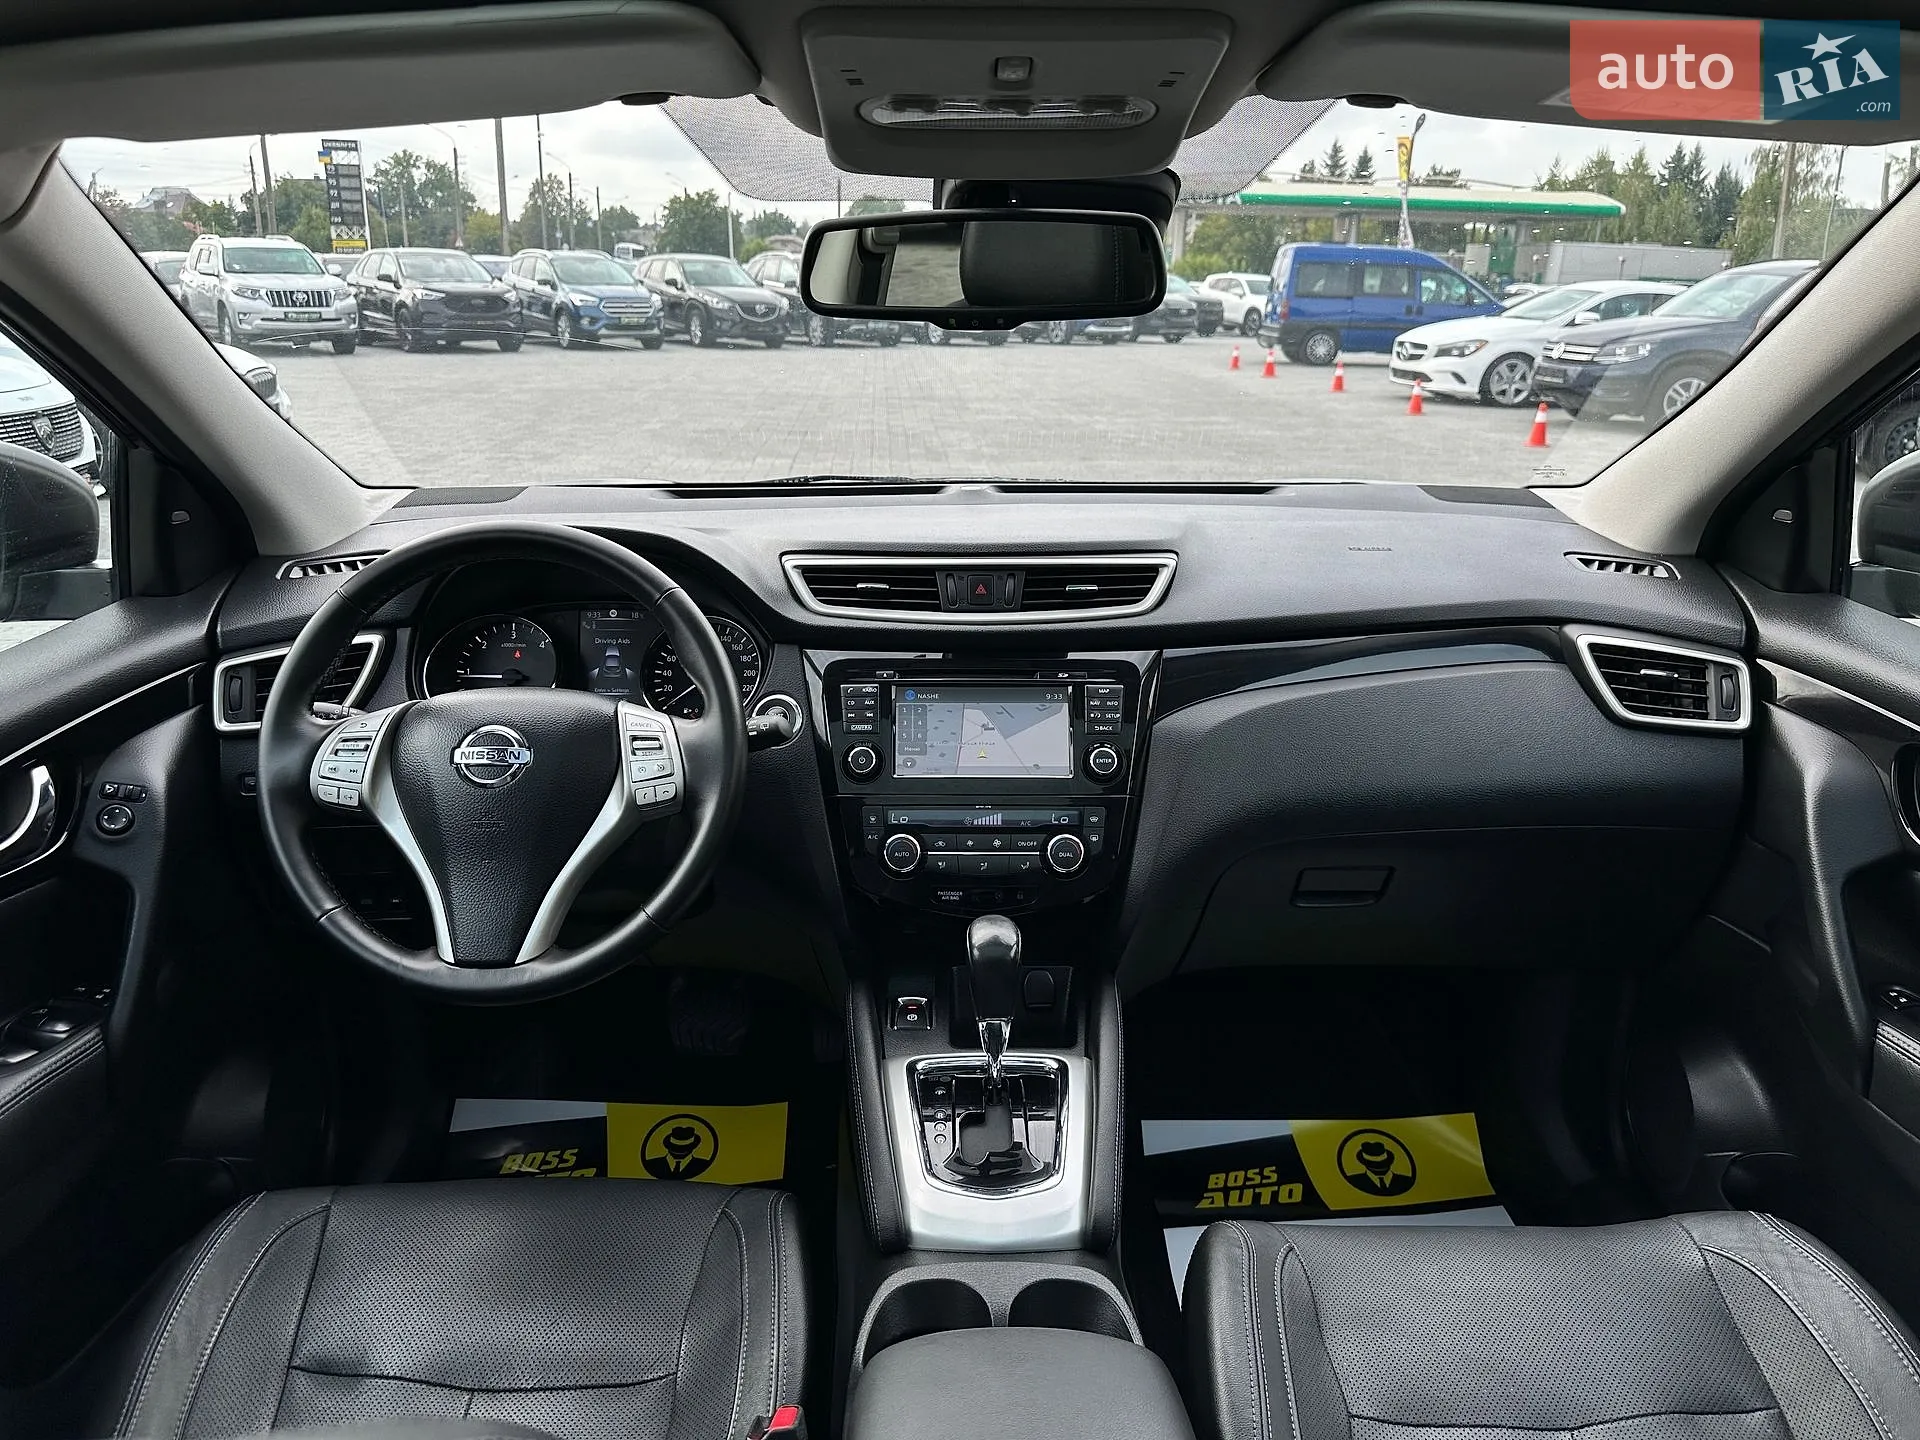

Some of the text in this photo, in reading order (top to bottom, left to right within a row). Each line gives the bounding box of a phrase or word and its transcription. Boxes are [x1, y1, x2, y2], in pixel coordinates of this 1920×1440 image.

[511, 631, 517, 639] 3
[720, 634, 732, 643] 140
[482, 641, 488, 649] 2
[539, 641, 545, 649] 4
[731, 643, 743, 651] 160
[743, 669, 756, 677] 200
[663, 684, 673, 692] 20
[742, 684, 755, 692] 220
[1045, 692, 1063, 700] 9:33
[460, 750, 521, 761] NISSAN
[891, 813, 909, 824] Lo
[1051, 813, 1069, 824] Lo
[1020, 819, 1032, 827] A/C
[1207, 1166, 1278, 1189] BOSS
[1194, 1182, 1303, 1209] AUTO
